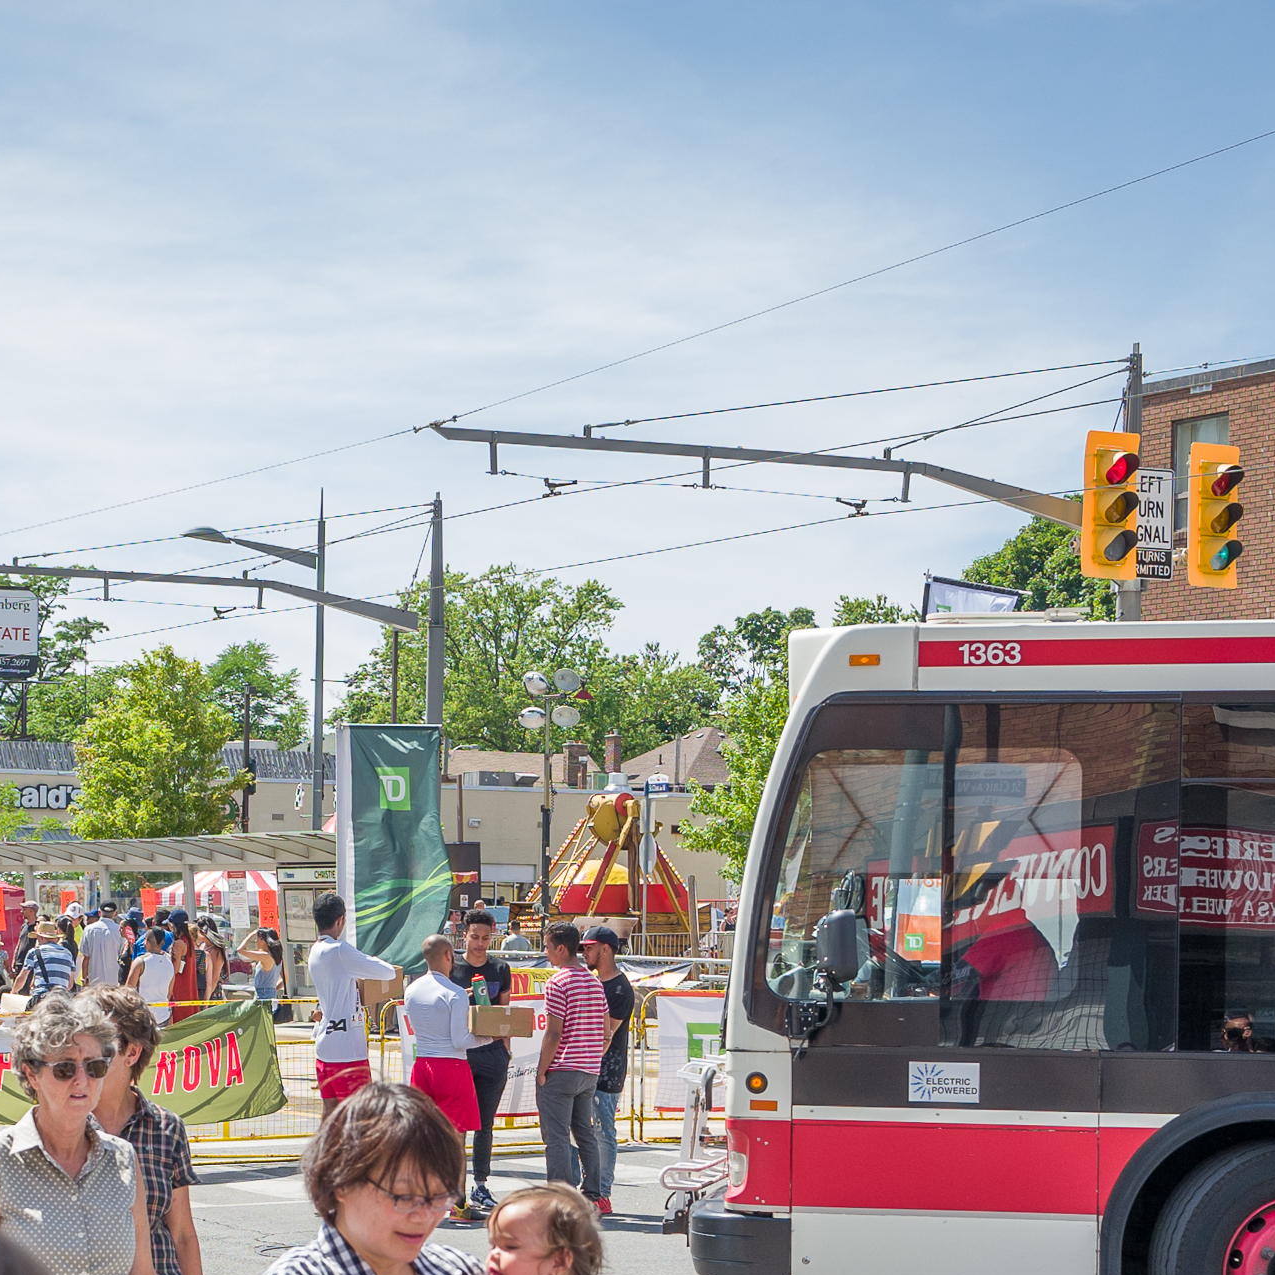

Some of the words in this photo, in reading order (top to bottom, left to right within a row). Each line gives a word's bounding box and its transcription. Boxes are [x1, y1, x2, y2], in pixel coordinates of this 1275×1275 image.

[1136, 475, 1163, 494] EFT
[1138, 500, 1164, 519] URN
[1137, 524, 1169, 544] GNAL
[1137, 550, 1166, 562] TURNS
[1136, 564, 1170, 577] RMITTED
[959, 642, 1022, 665] 1363
[314, 870, 336, 879] CHRISTIE
[906, 936, 923, 948] TD
[478, 985, 488, 996] G
[152, 1031, 245, 1096] NOVA
[926, 1077, 971, 1086] ELECTRIC
[931, 1086, 978, 1095] POWERED
